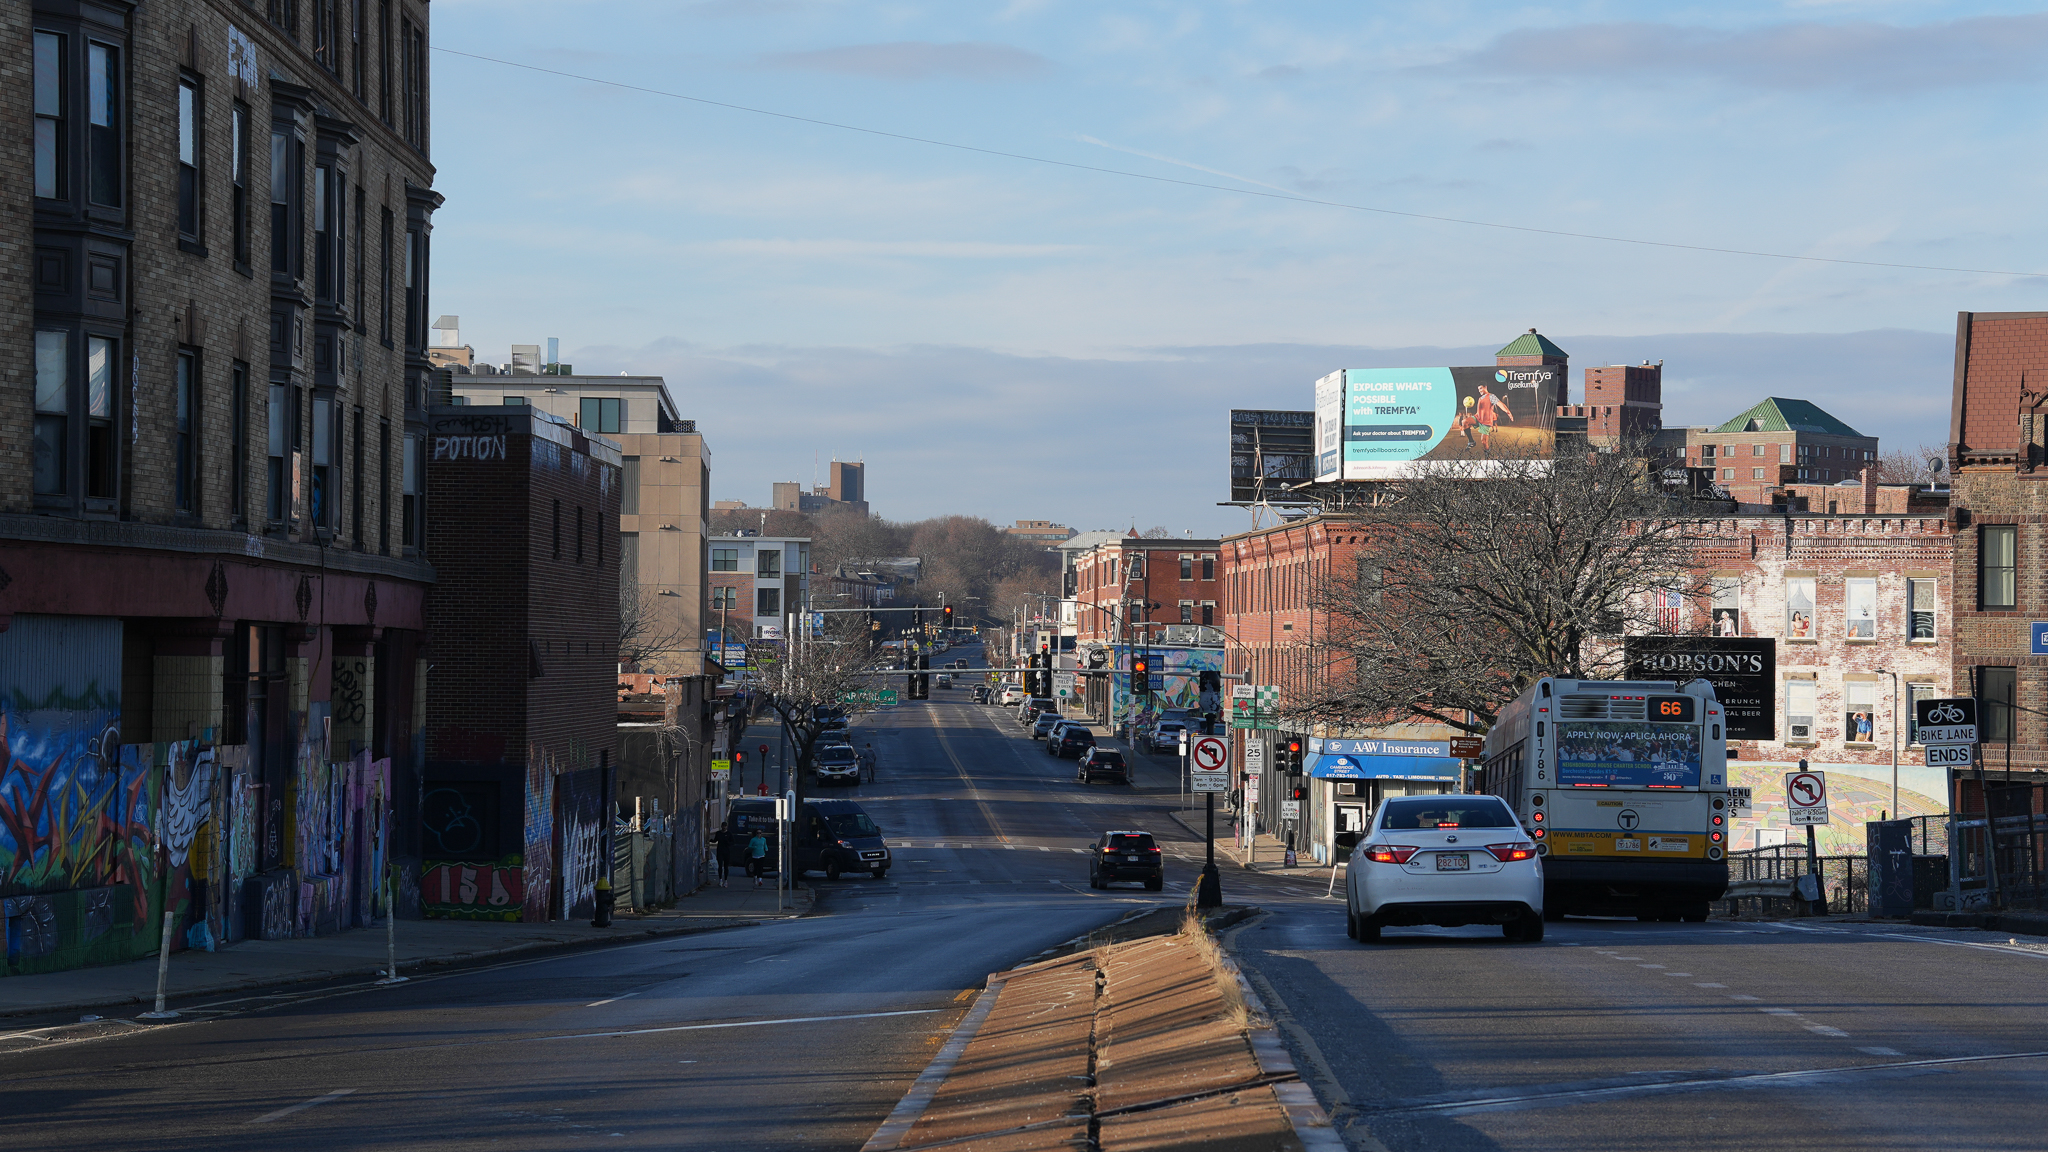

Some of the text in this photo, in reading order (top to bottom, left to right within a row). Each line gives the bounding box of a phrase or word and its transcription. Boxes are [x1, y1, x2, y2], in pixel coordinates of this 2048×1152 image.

[1353, 382, 1432, 391] EXPLORE WHAT'S
[1353, 395, 1396, 404] POSSIBLE
[1353, 406, 1372, 415] with
[434, 434, 506, 461] POTION
[1660, 701, 1682, 715] 66
[1658, 732, 1692, 740] AHORA
[1921, 728, 1974, 740] BIKE LANE
[1247, 749, 1260, 757] 25
[1352, 742, 1440, 755] AAW Insurance
[1537, 738, 1545, 780] 1786
[1930, 748, 1968, 762] ENDS
[1438, 857, 1452, 867] 282
[1454, 857, 1467, 867] TC9
